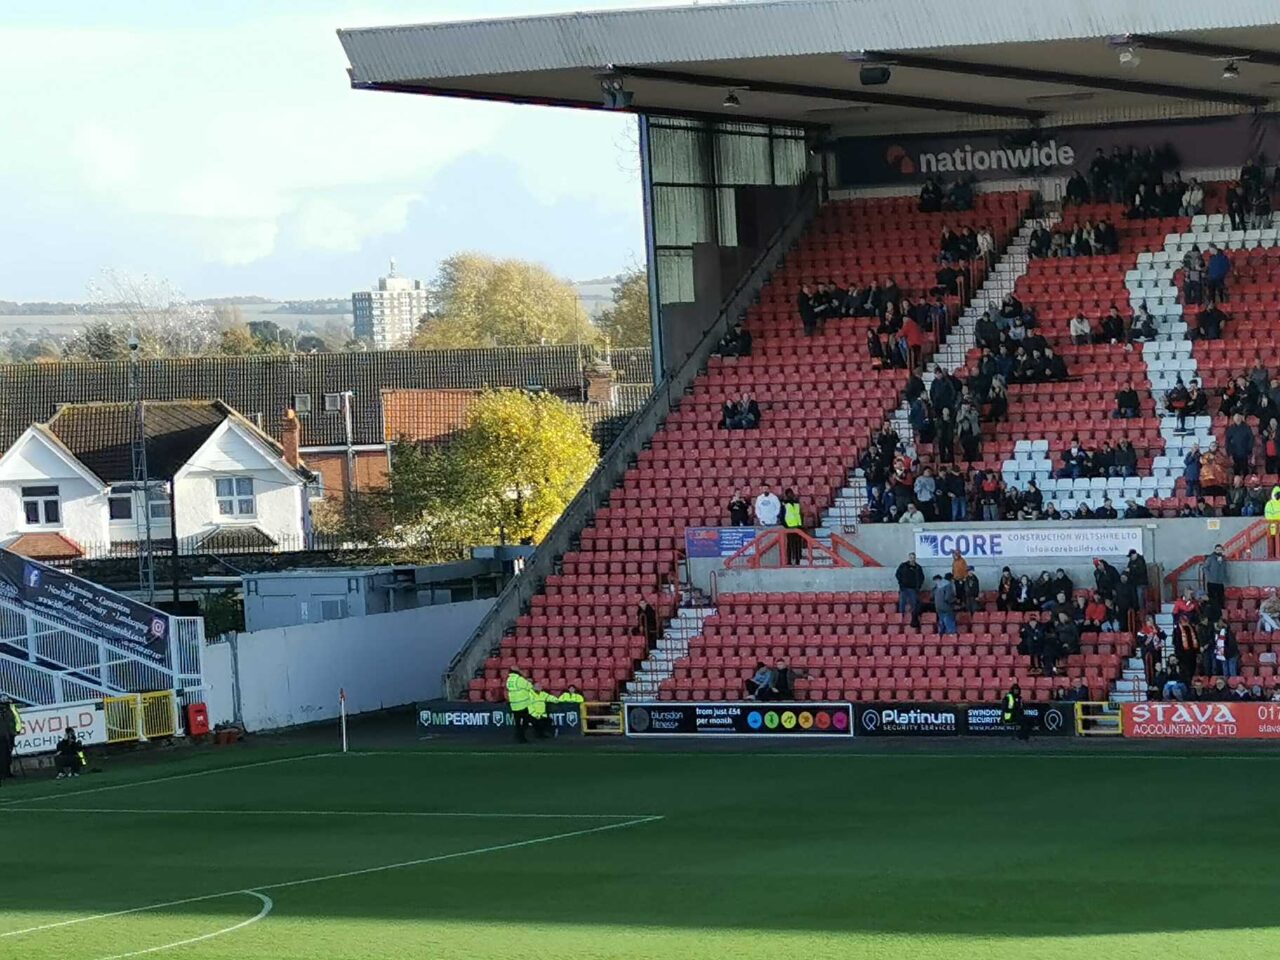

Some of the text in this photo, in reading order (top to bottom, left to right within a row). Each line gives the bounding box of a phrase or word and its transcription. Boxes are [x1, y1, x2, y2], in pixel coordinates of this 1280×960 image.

[919, 140, 1075, 173] nationwide
[1007, 533, 1072, 542] CONSTRUCTION
[1074, 532, 1119, 541] WILTSHIRE
[940, 533, 1004, 557] CORE
[696, 707, 713, 715] from
[881, 709, 956, 724] Platinum
[432, 712, 490, 726] MIPERMIT
[696, 716, 733, 726] per month
[968, 716, 1001, 724] SECURITY
[1133, 724, 1237, 735] ACCOUNTANCY LTD
